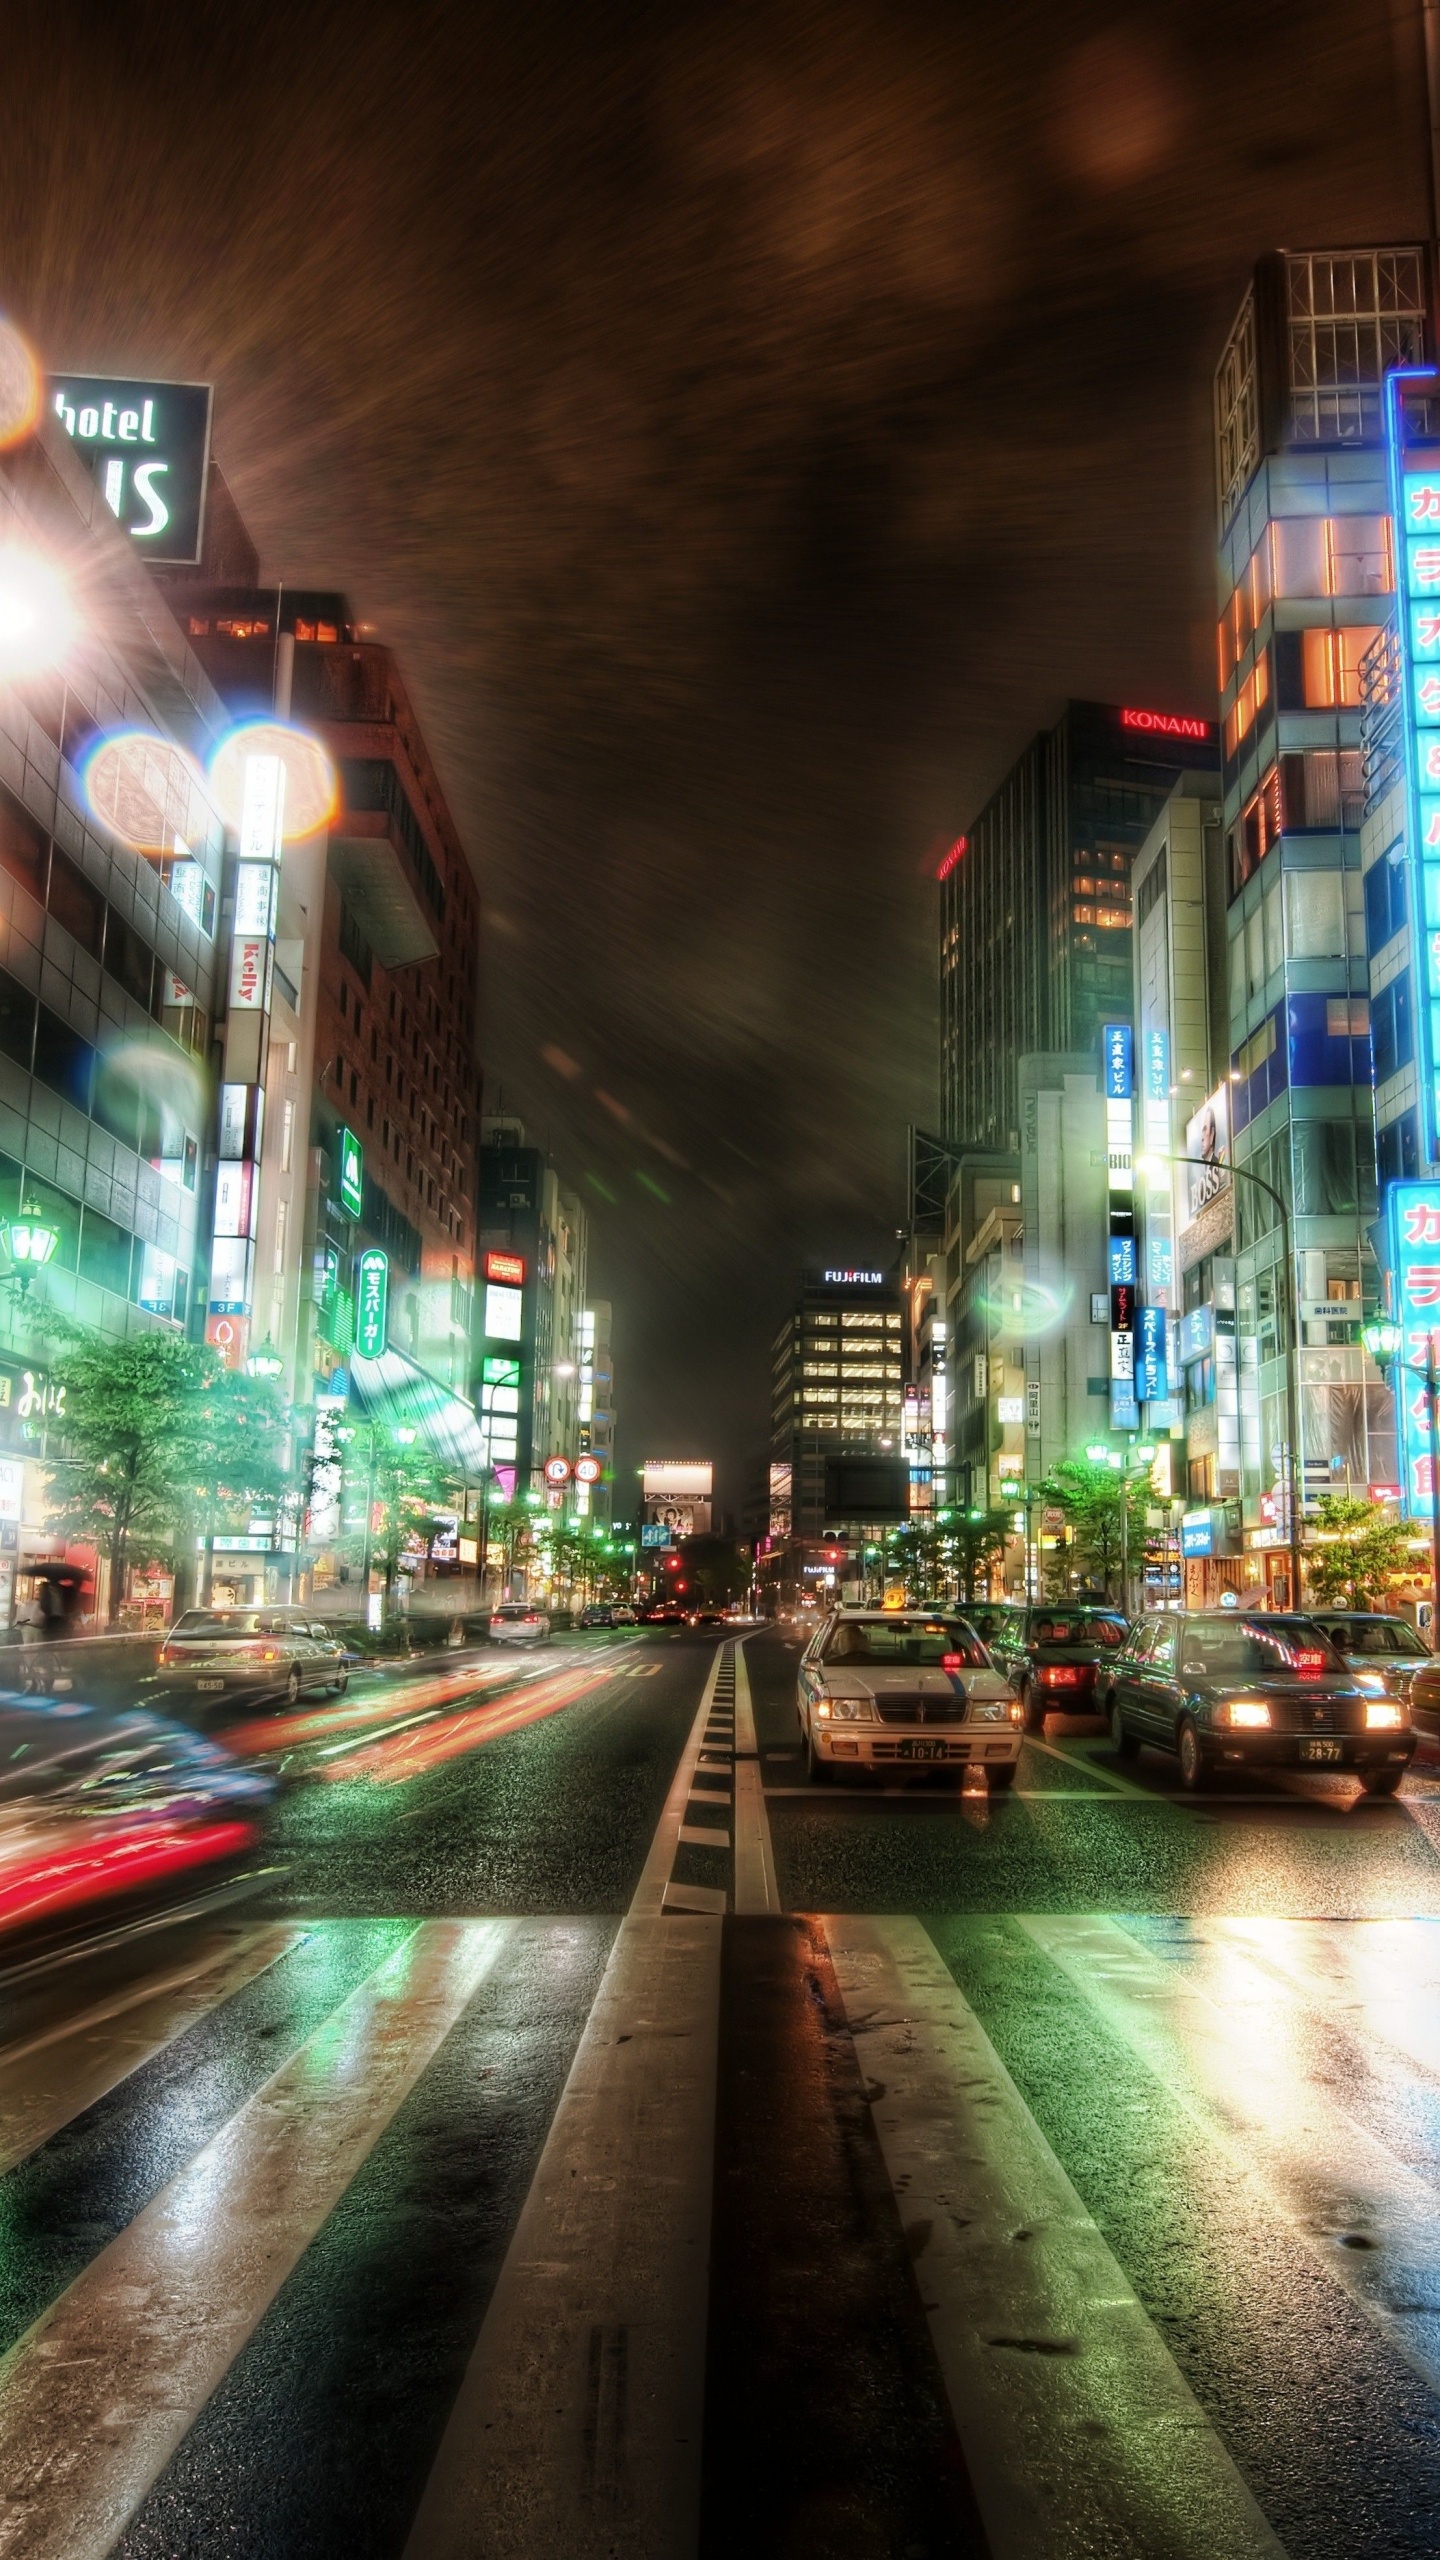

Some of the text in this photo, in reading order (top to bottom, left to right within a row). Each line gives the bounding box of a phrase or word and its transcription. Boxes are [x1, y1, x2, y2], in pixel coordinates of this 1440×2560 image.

[56, 394, 155, 442] hotel
[1123, 709, 1205, 737] KONAMI
[238, 943, 260, 1002] Kelly
[1110, 1030, 1125, 1095] 正直家ビル
[1190, 1164, 1220, 1213] BOSS
[825, 1270, 882, 1284] FUJIFILM
[1111, 1253, 1122, 1282] ポイント
[217, 1303, 236, 1313] 3F
[364, 1272, 380, 1350] モスバーガー
[1314, 1306, 1348, 1315] 歯科医院
[1028, 1391, 1039, 1417] 阿里山
[579, 1467, 596, 1478] 40
[1299, 1652, 1322, 1665] 空車
[912, 1746, 943, 1759] 10-14
[1308, 1747, 1341, 1760] 28-77
